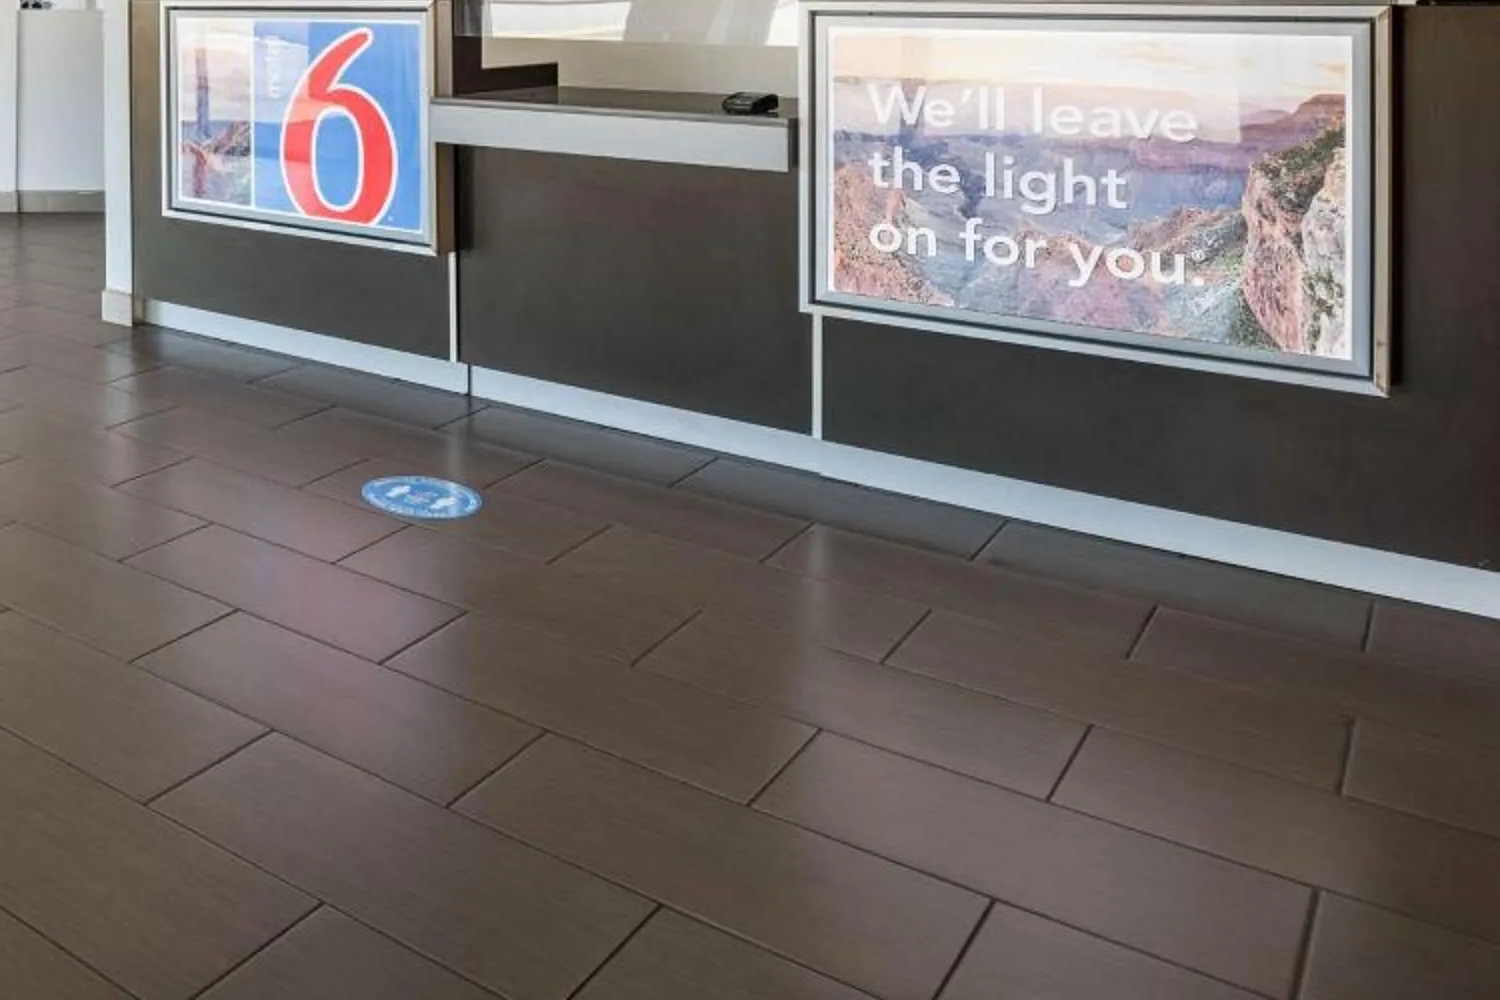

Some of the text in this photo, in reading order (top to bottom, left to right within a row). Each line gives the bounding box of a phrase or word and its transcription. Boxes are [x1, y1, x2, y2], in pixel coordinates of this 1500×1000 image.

[280, 26, 399, 227] 6
[868, 82, 1200, 143] We'll leave
[868, 146, 1128, 217] the light
[868, 219, 937, 258] on
[959, 217, 1048, 269] for
